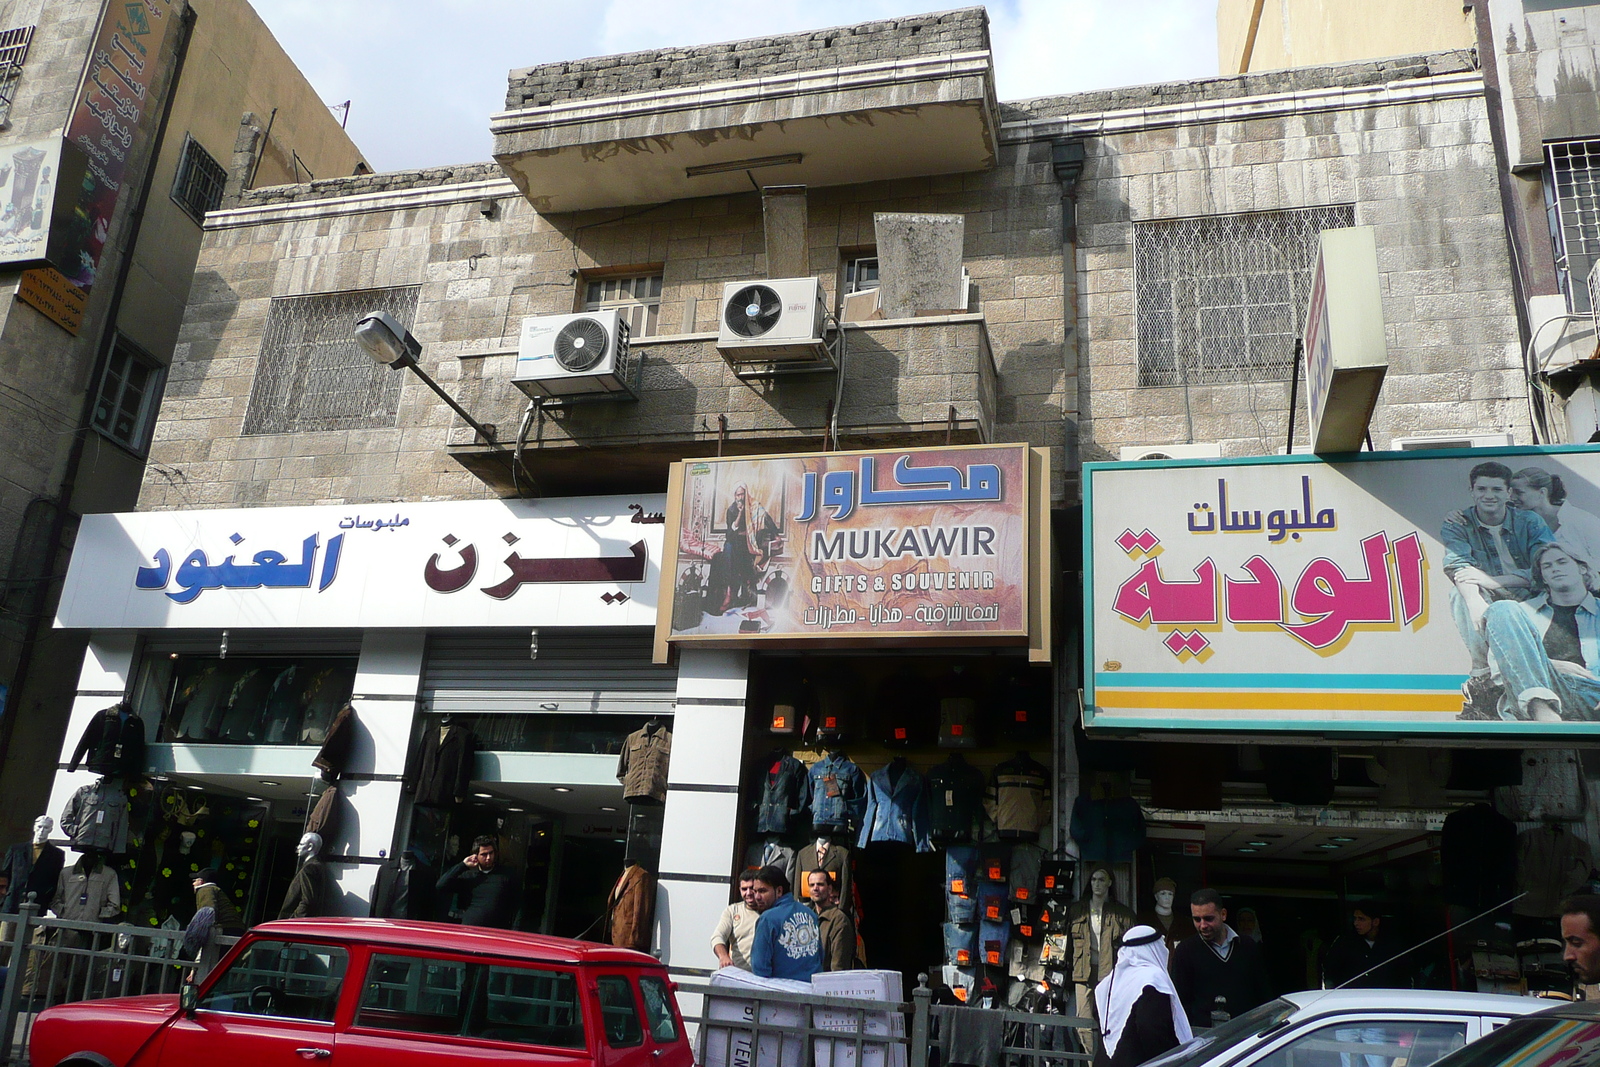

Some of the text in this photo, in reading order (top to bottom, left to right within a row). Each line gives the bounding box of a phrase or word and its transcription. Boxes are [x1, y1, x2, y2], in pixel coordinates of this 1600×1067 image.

[95, 50, 146, 100] العطور
[111, 33, 144, 75] بيع
[91, 64, 139, 122] الزيتية
[794, 455, 1002, 522] مكاور
[1187, 475, 1336, 541] ملبوسات
[338, 513, 410, 531] ملبوسات
[812, 526, 996, 561] MUKAWIR
[135, 531, 346, 605] العنود
[424, 532, 650, 606] يزن
[811, 571, 995, 593] GIFTS & SOUVENIR
[868, 602, 903, 625] هدايا
[915, 601, 963, 626] شرقية
[965, 602, 999, 622] تحف
[1111, 528, 1426, 657] الودية
[803, 604, 856, 628] مطرزات
